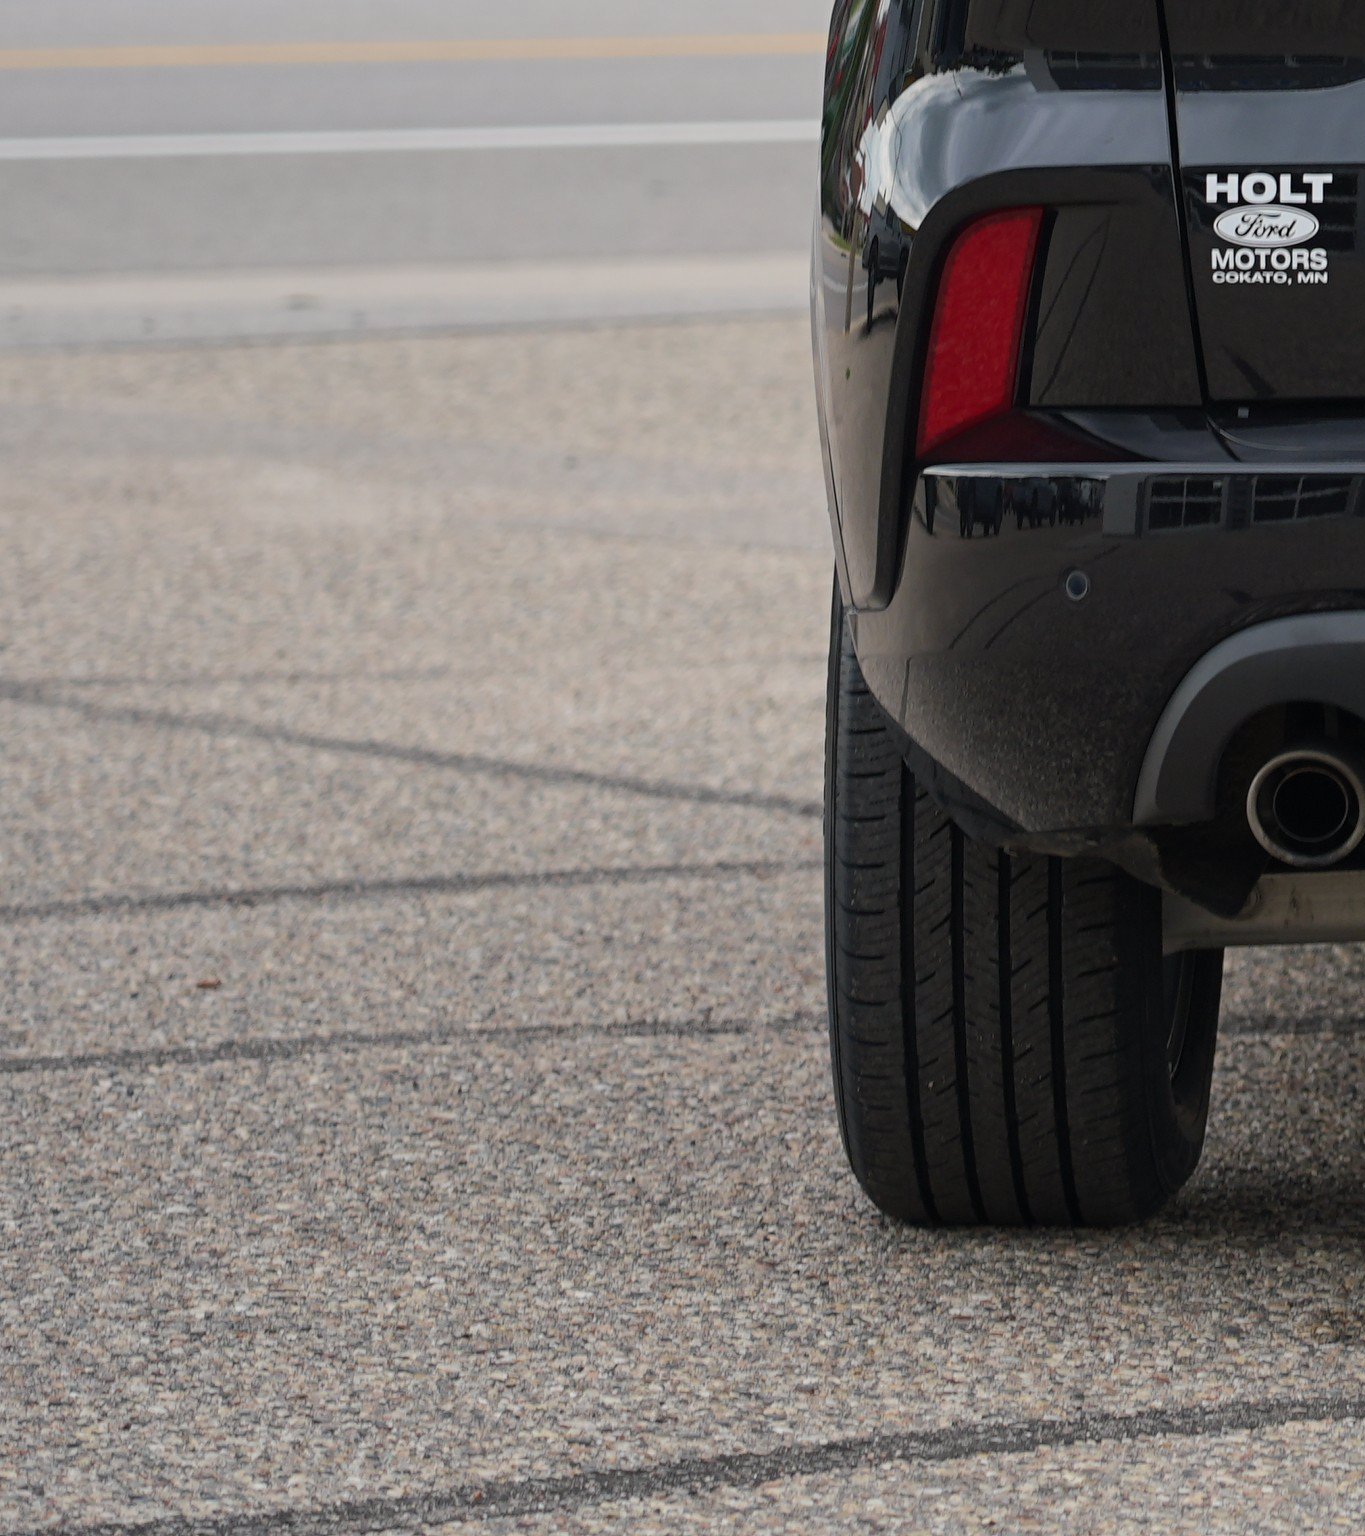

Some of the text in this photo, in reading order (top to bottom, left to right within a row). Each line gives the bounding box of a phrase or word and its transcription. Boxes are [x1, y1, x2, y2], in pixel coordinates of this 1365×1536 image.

[1205, 172, 1333, 204] HOLT
[1234, 213, 1297, 238] Ford
[1211, 248, 1328, 270] MOTORS
[1212, 271, 1328, 286] COKATO, MN
